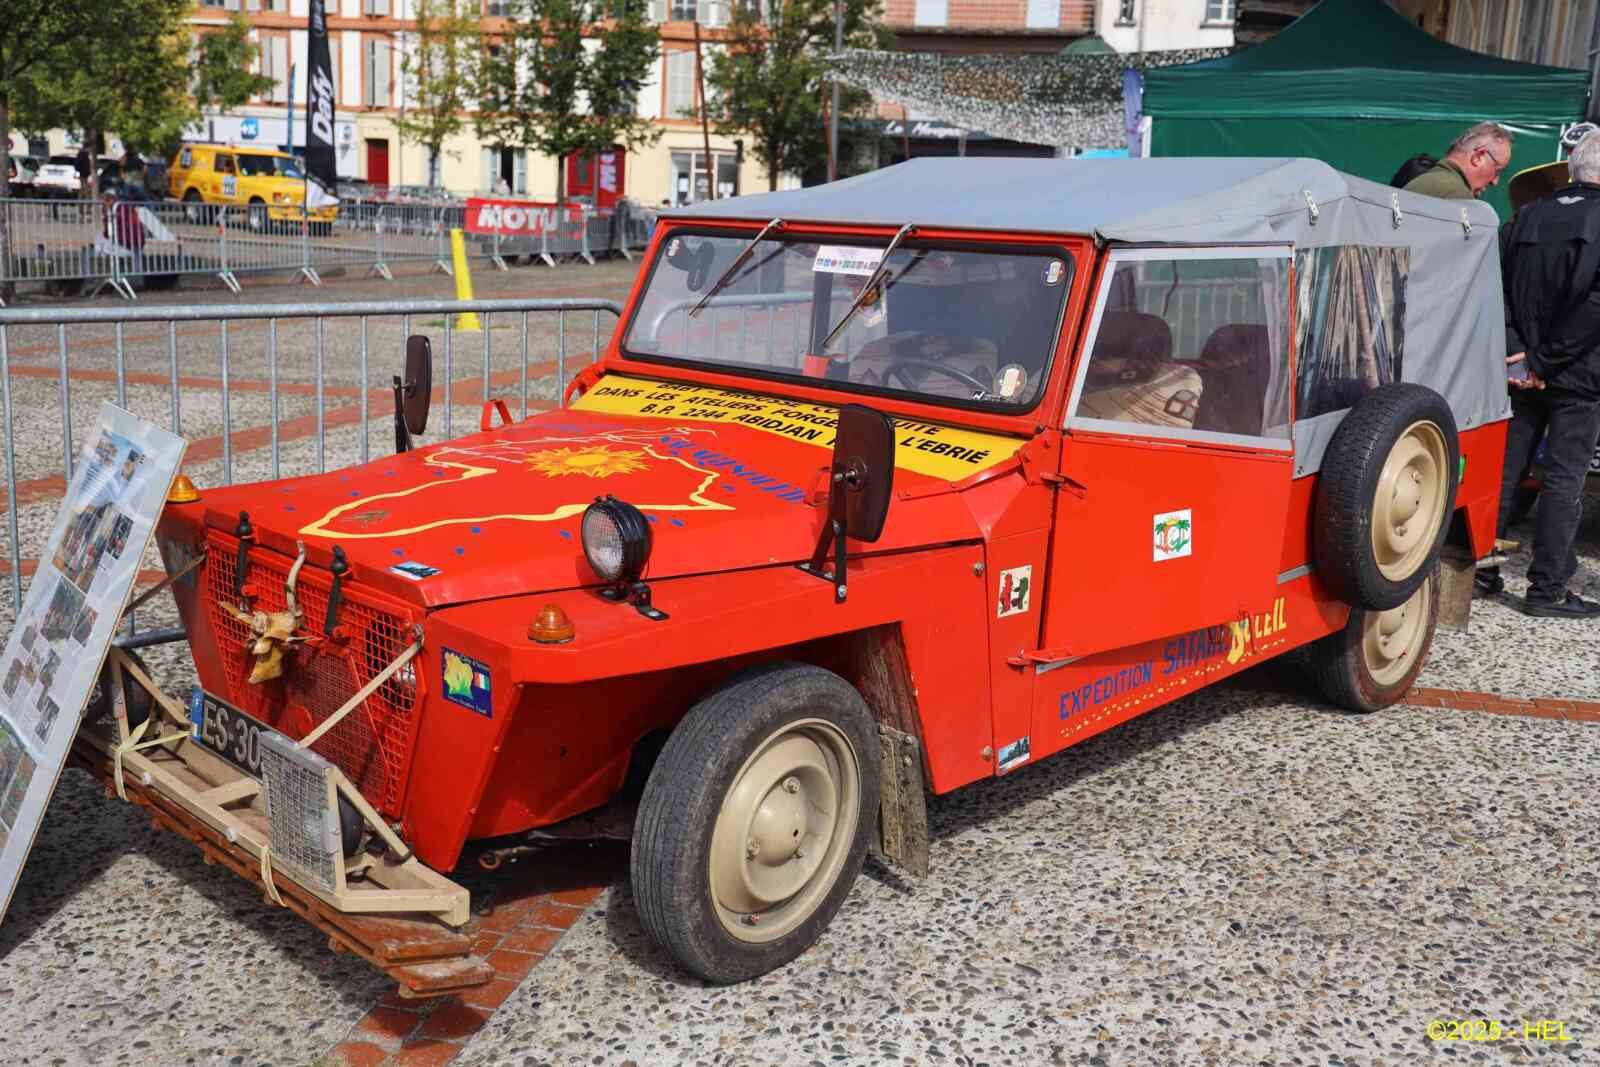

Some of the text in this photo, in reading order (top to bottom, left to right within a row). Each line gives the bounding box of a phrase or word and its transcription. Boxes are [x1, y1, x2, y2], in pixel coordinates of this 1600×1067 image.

[594, 387, 992, 464] DANS LES ATELIERS FORGE L'EBRIÉ
[680, 408, 728, 419] 2244
[732, 413, 823, 440] ABIDJAN
[1058, 657, 1153, 721] EXPEDITION
